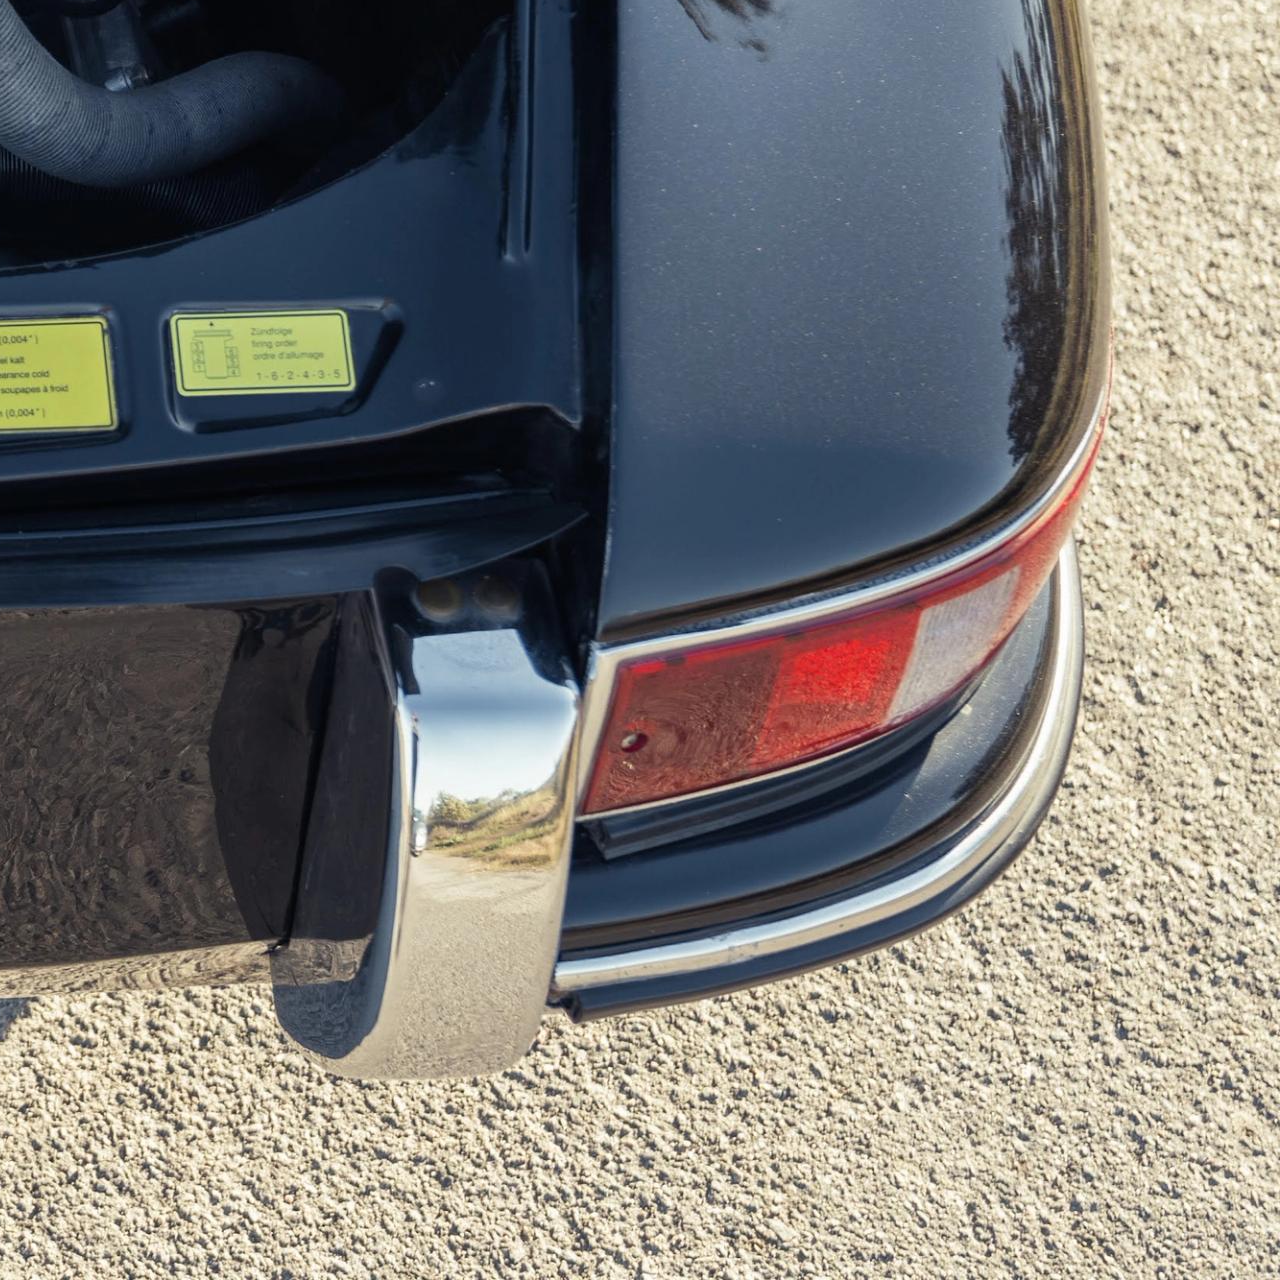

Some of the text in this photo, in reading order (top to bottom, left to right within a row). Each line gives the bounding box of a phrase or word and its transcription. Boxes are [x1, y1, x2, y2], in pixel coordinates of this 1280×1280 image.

[251, 339, 298, 349] firing order
[10, 356, 26, 364] kalt
[252, 352, 276, 361] ordre
[31, 370, 50, 378] cold
[1, 386, 41, 396] soupapes
[49, 385, 69, 393] froid
